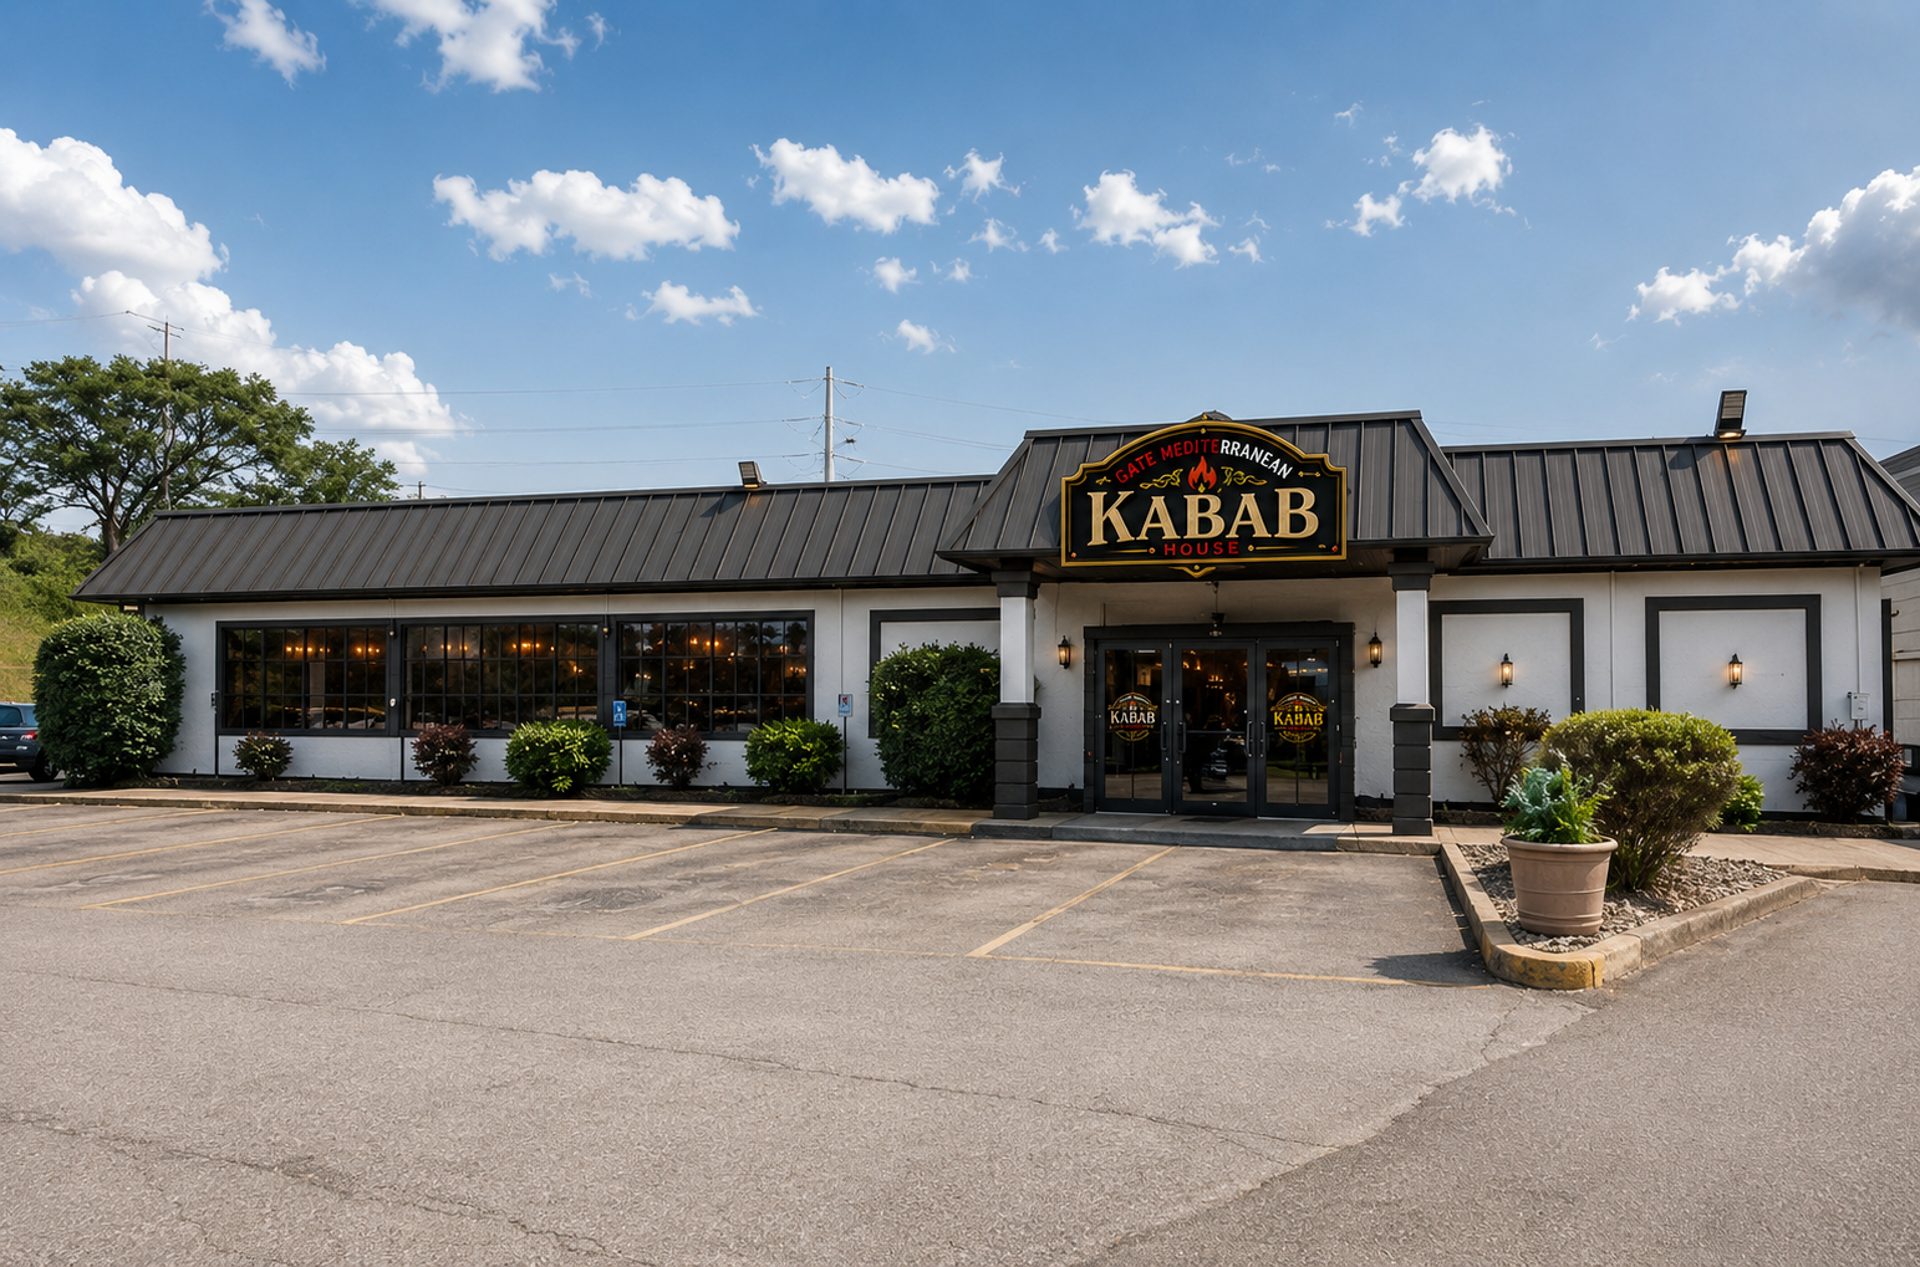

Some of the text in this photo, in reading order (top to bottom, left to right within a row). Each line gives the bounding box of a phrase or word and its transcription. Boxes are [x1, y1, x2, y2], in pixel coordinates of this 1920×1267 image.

[1115, 438, 1293, 483] GATE MEDITERRANEAN
[1087, 487, 1320, 547] KABAB
[1164, 541, 1240, 556] HOUSE
[1110, 710, 1156, 724] KABAB
